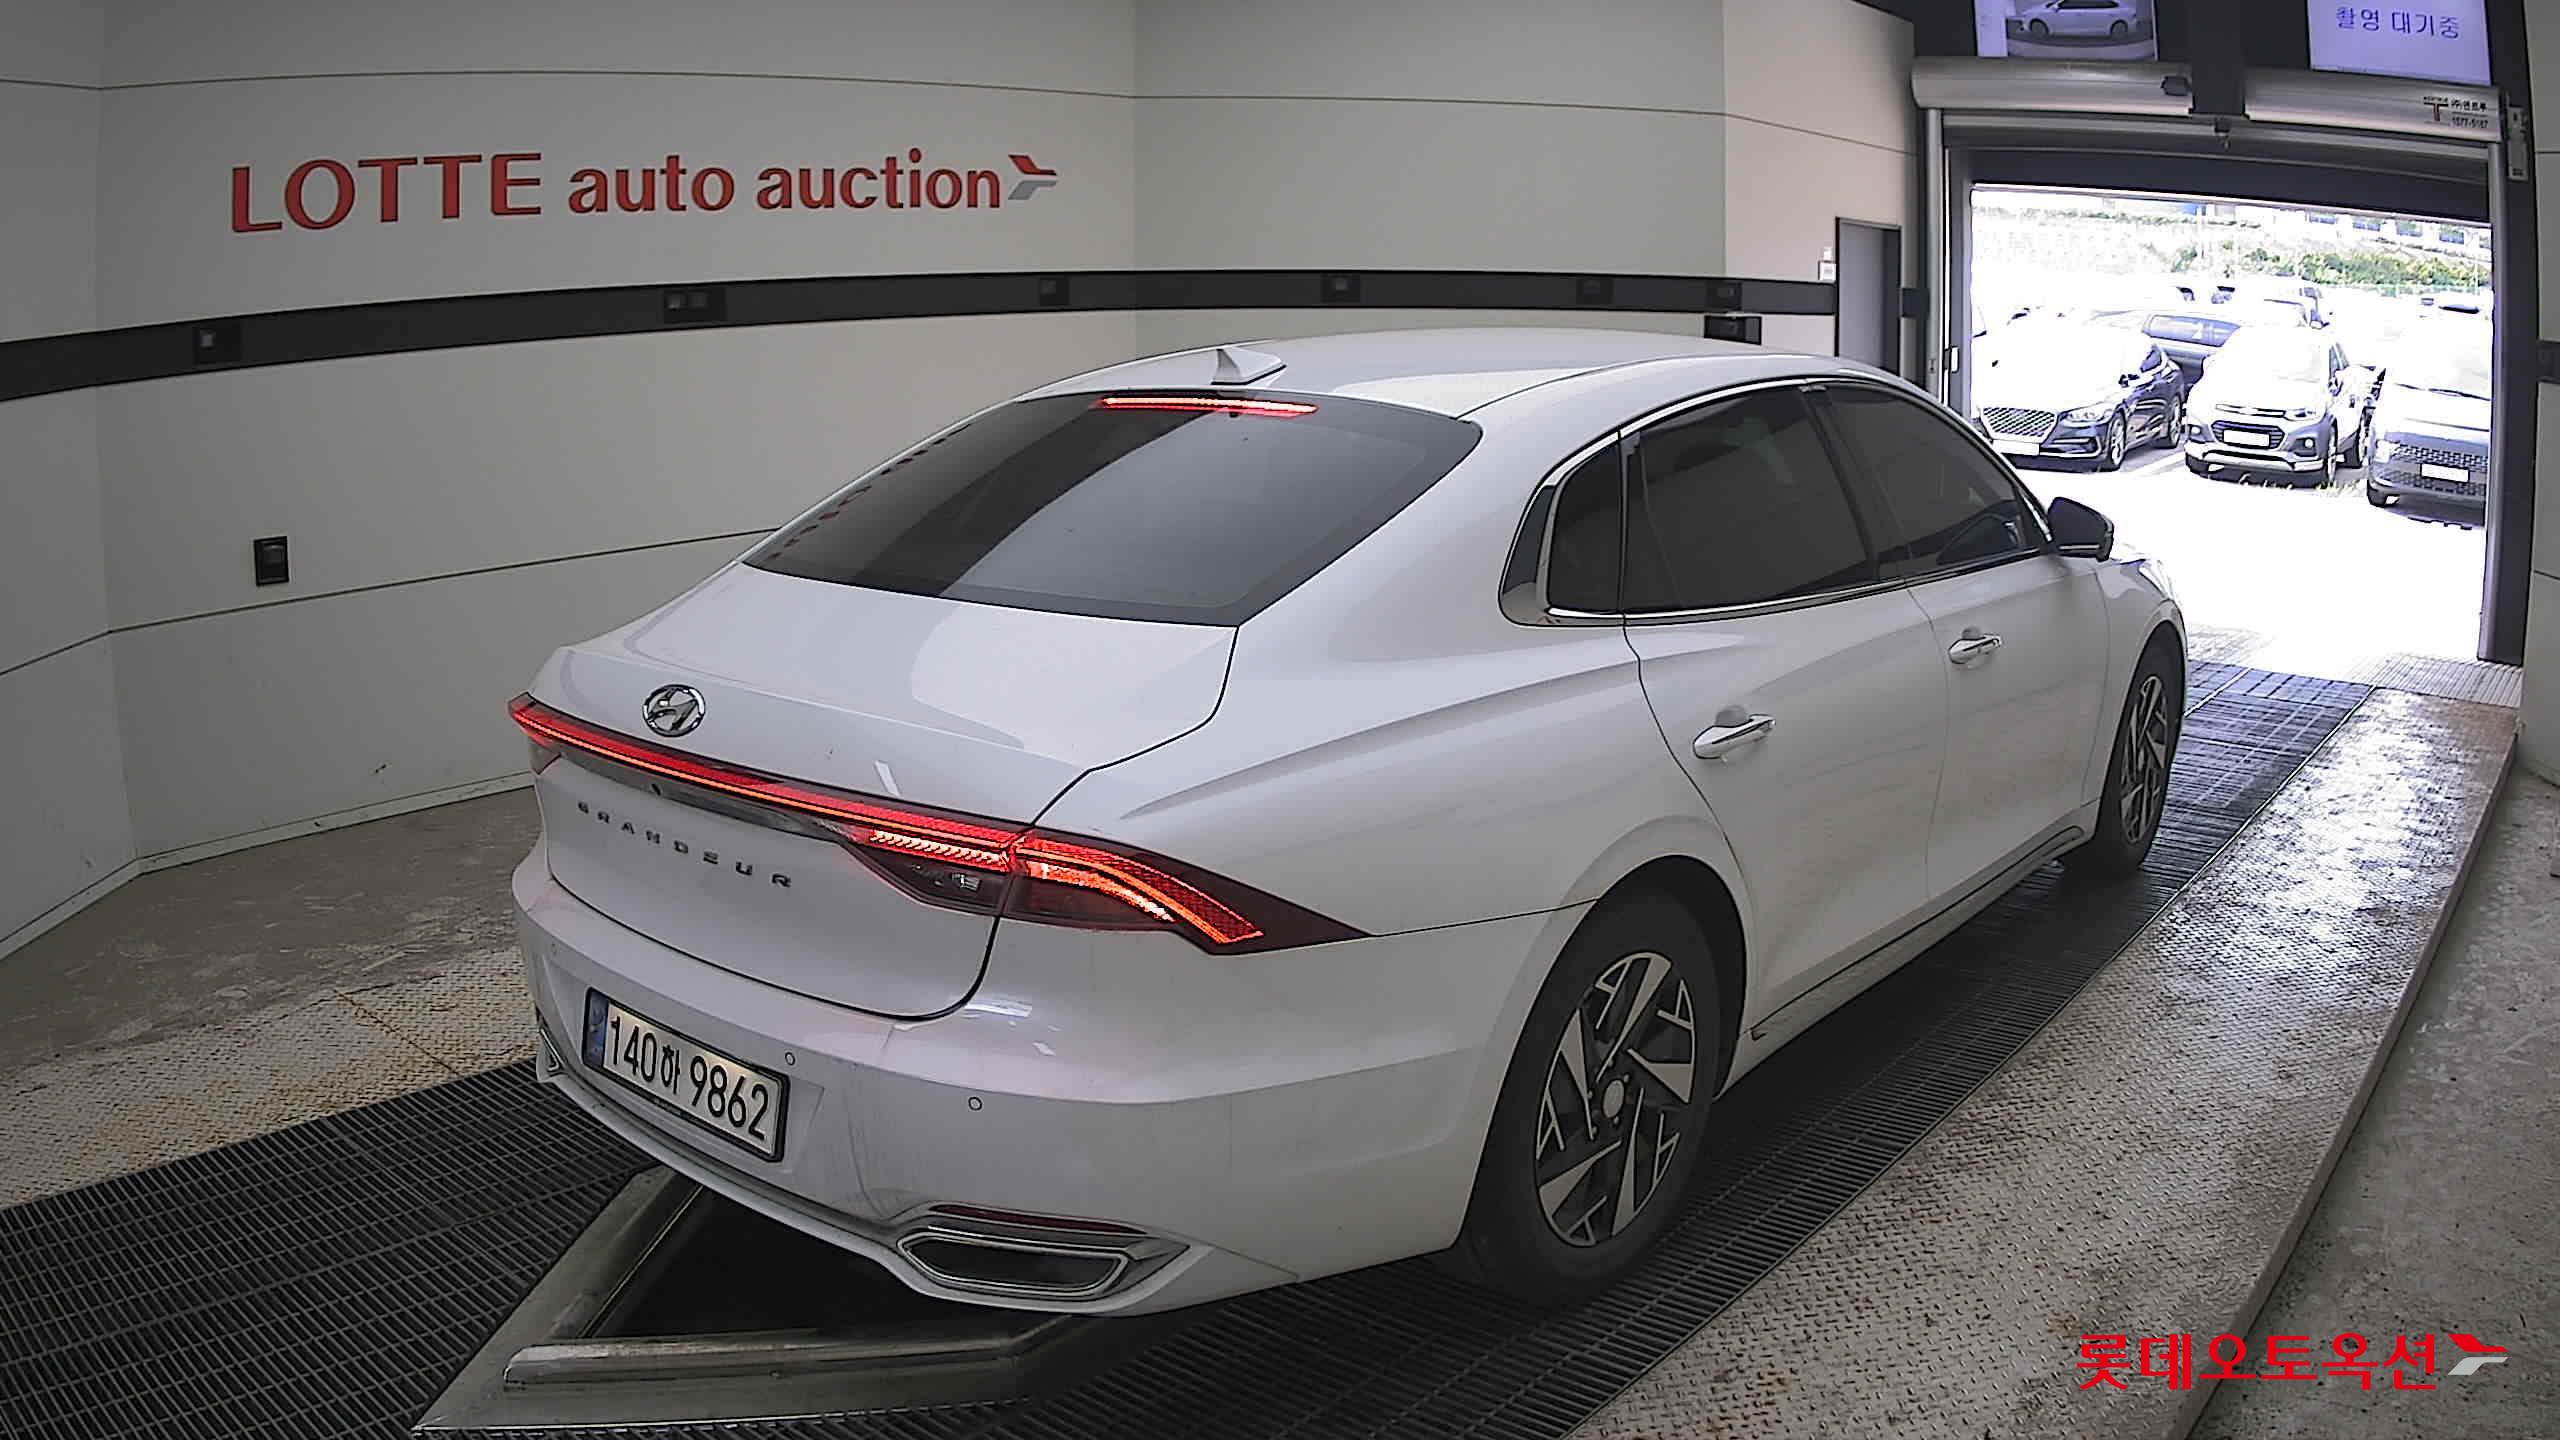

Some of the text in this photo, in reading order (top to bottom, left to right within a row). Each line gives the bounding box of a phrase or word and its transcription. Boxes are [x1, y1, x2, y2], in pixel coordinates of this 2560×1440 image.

[2337, 7, 2459, 39] 촬영 대기중
[230, 148, 1001, 233] LOTTE auto auction
[578, 802, 791, 888] GRANDEUR
[610, 1015, 769, 1141] 140하 9862
